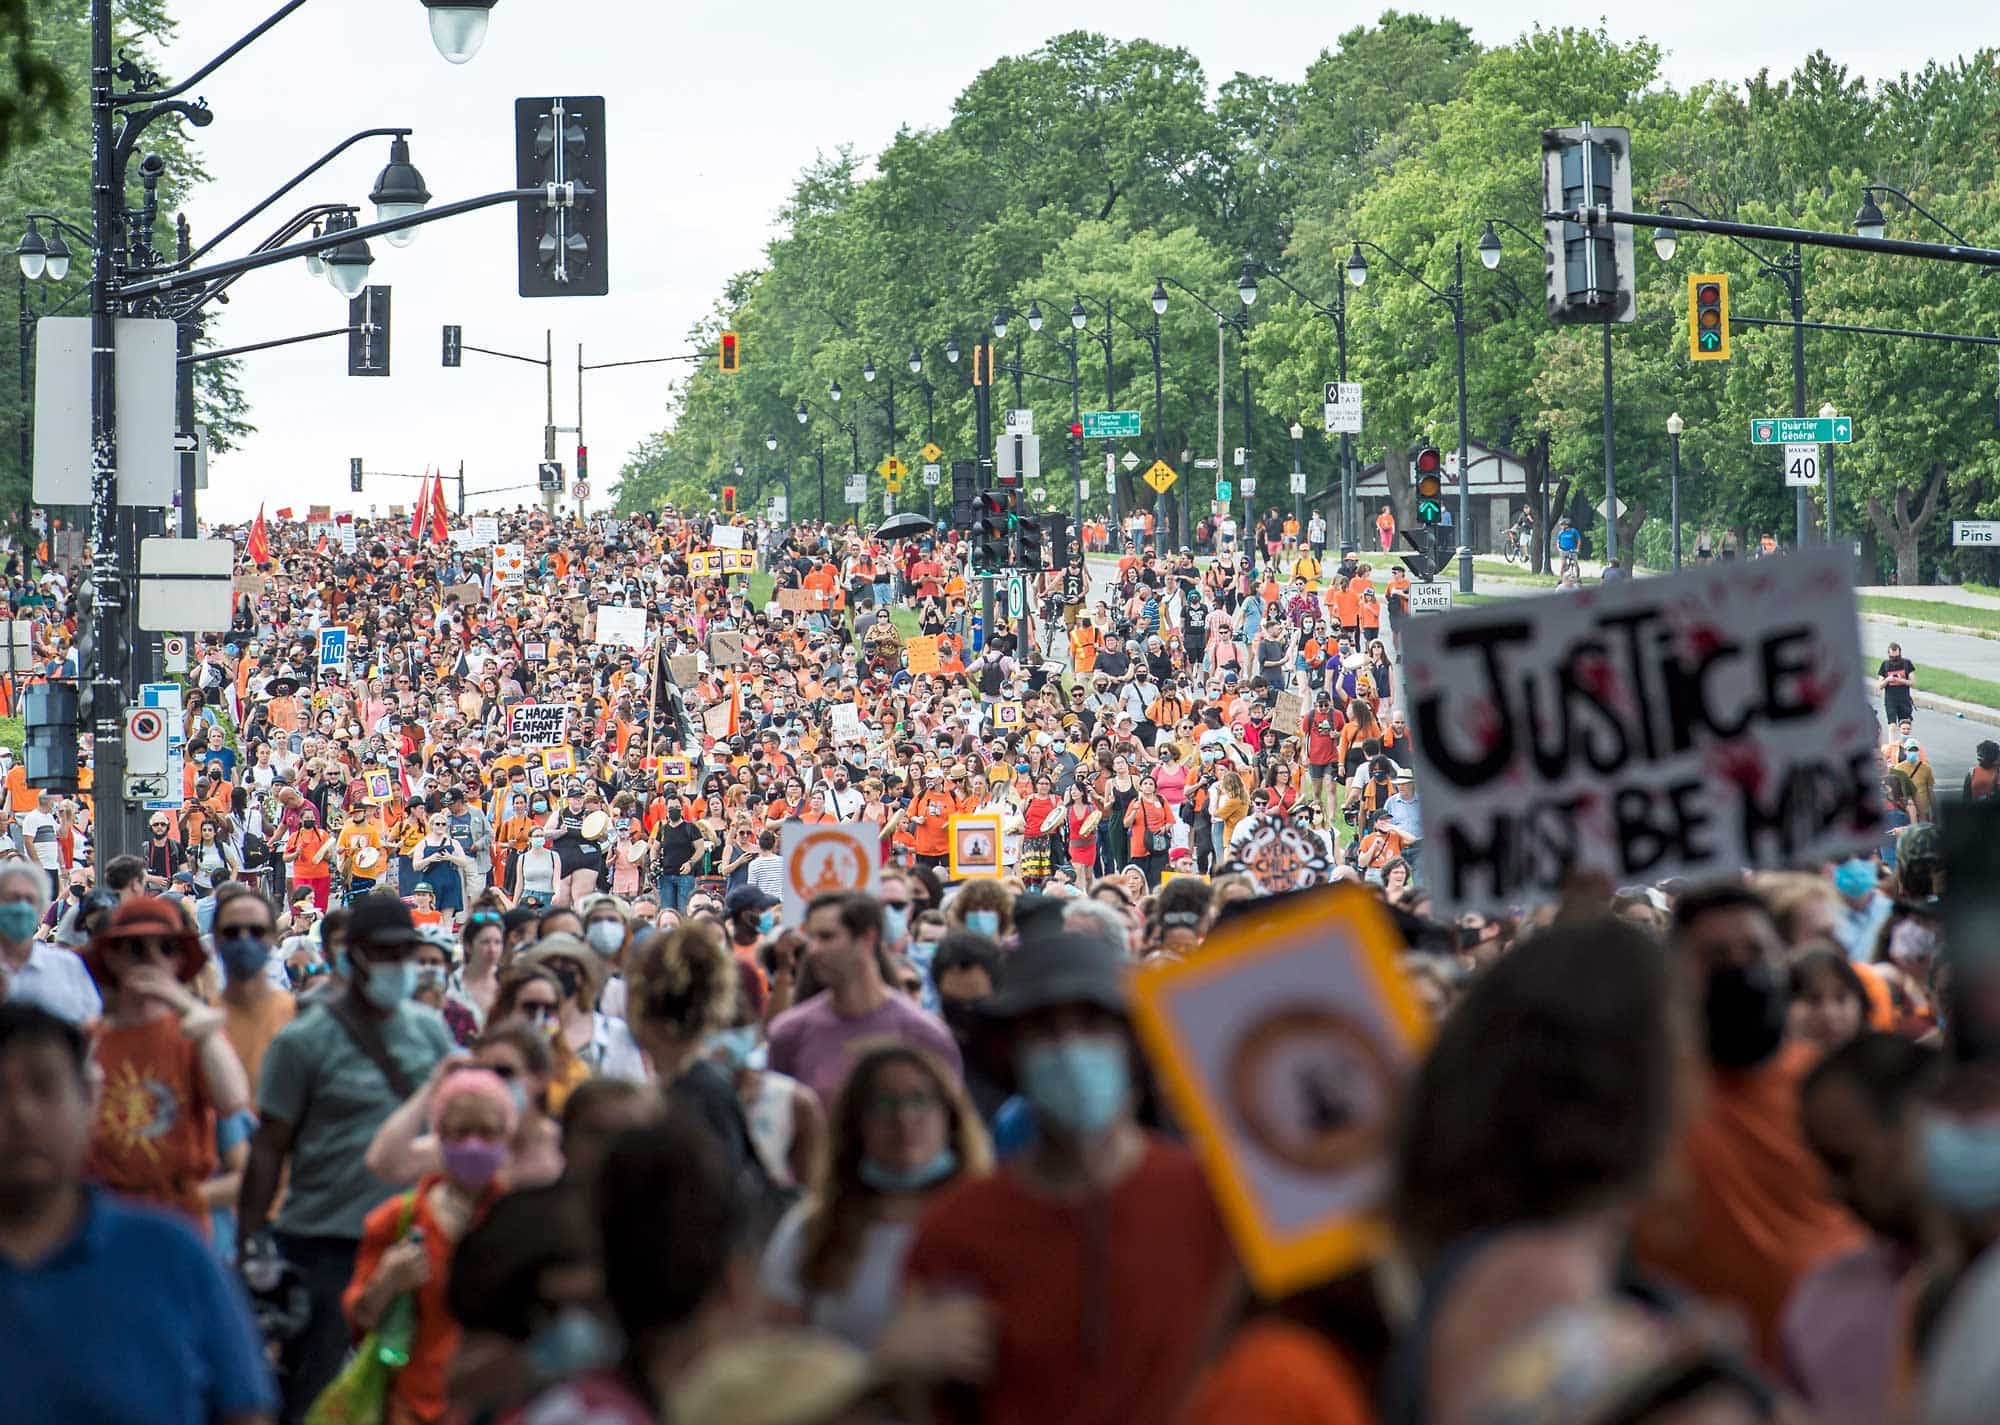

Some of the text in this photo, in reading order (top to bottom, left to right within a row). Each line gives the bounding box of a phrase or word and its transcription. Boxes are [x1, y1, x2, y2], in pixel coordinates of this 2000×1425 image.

[1782, 421, 1818, 430] Quartier
[1782, 431, 1815, 440] Général
[1790, 457, 1816, 479] 40
[926, 471, 939, 482] 40
[1961, 529, 1993, 541] Pins
[1418, 586, 1443, 596] LIGNE
[514, 707, 564, 720] CHAQUE
[513, 720, 562, 732] ENFANT
[521, 731, 562, 744] OMPTE
[1612, 782, 1713, 875] BE
